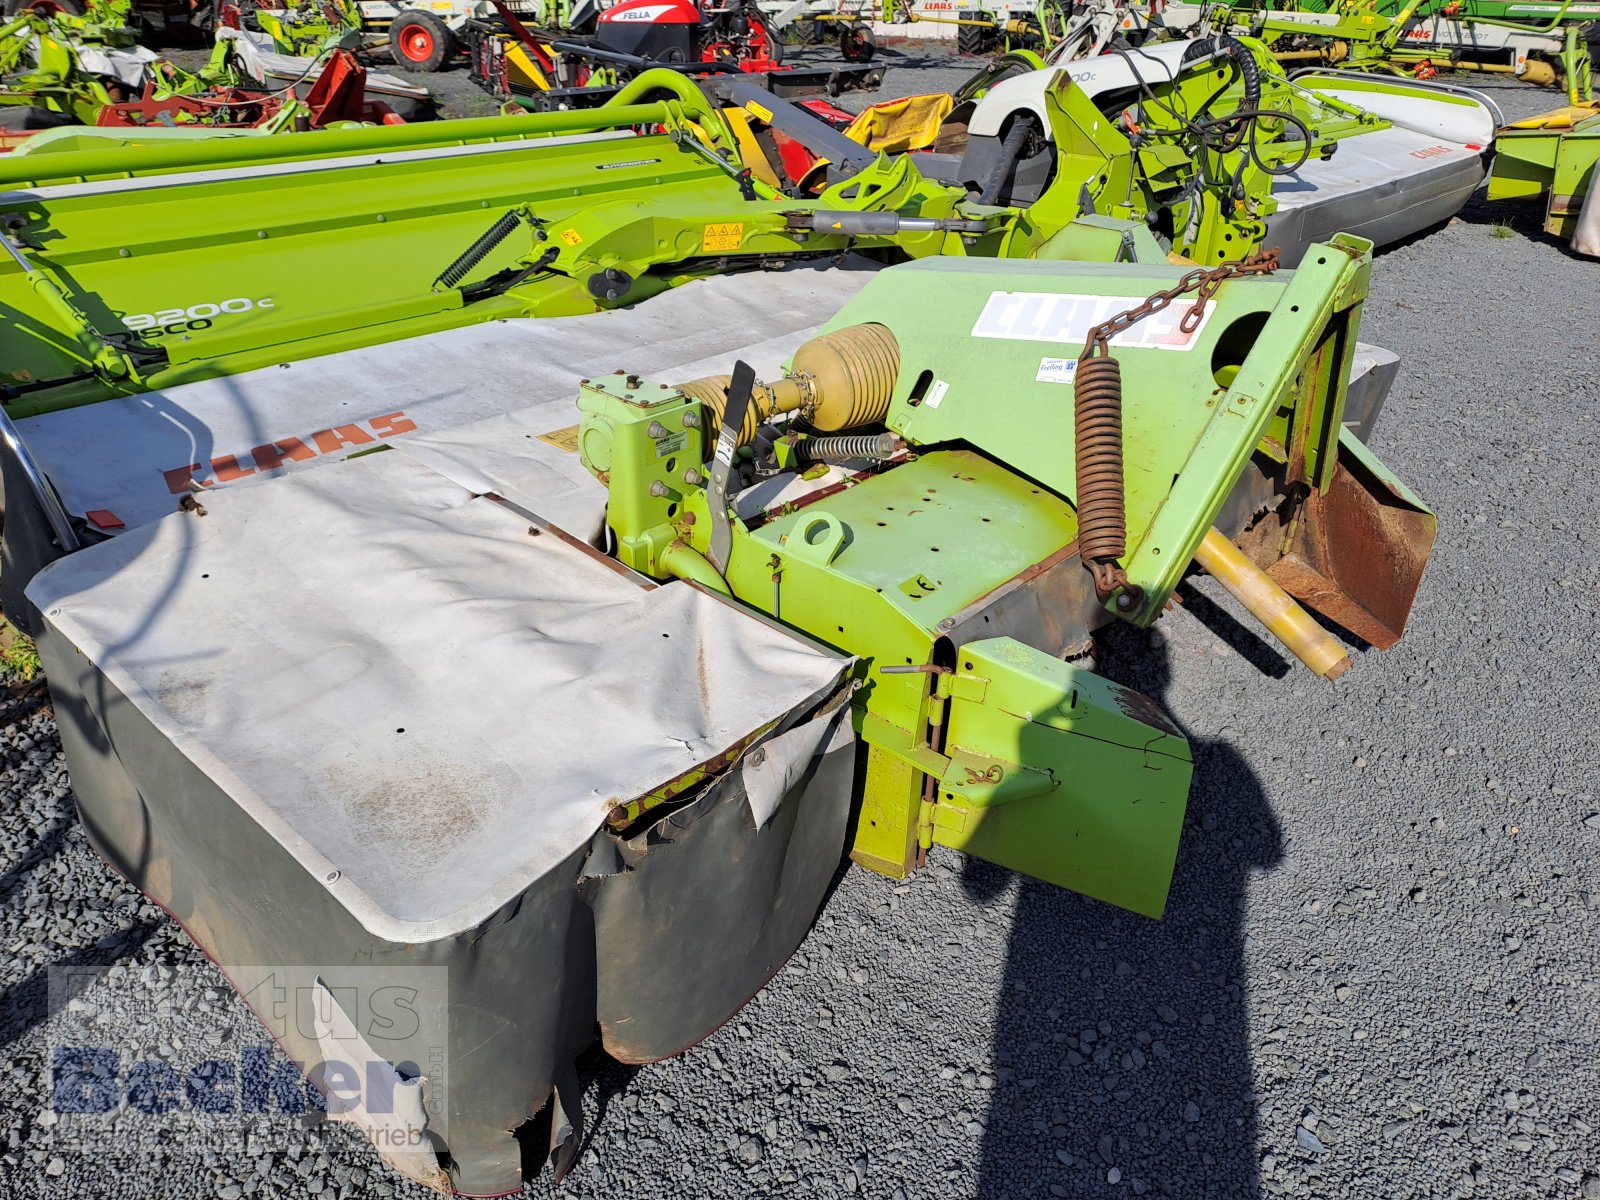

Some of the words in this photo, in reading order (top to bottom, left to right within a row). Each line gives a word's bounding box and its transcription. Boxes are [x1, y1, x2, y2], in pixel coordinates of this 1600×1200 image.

[623, 11, 650, 19] FELLA
[924, 2, 952, 10] CLAAS
[976, 295, 1195, 346] CLAAS
[163, 411, 417, 494] CLAAS
